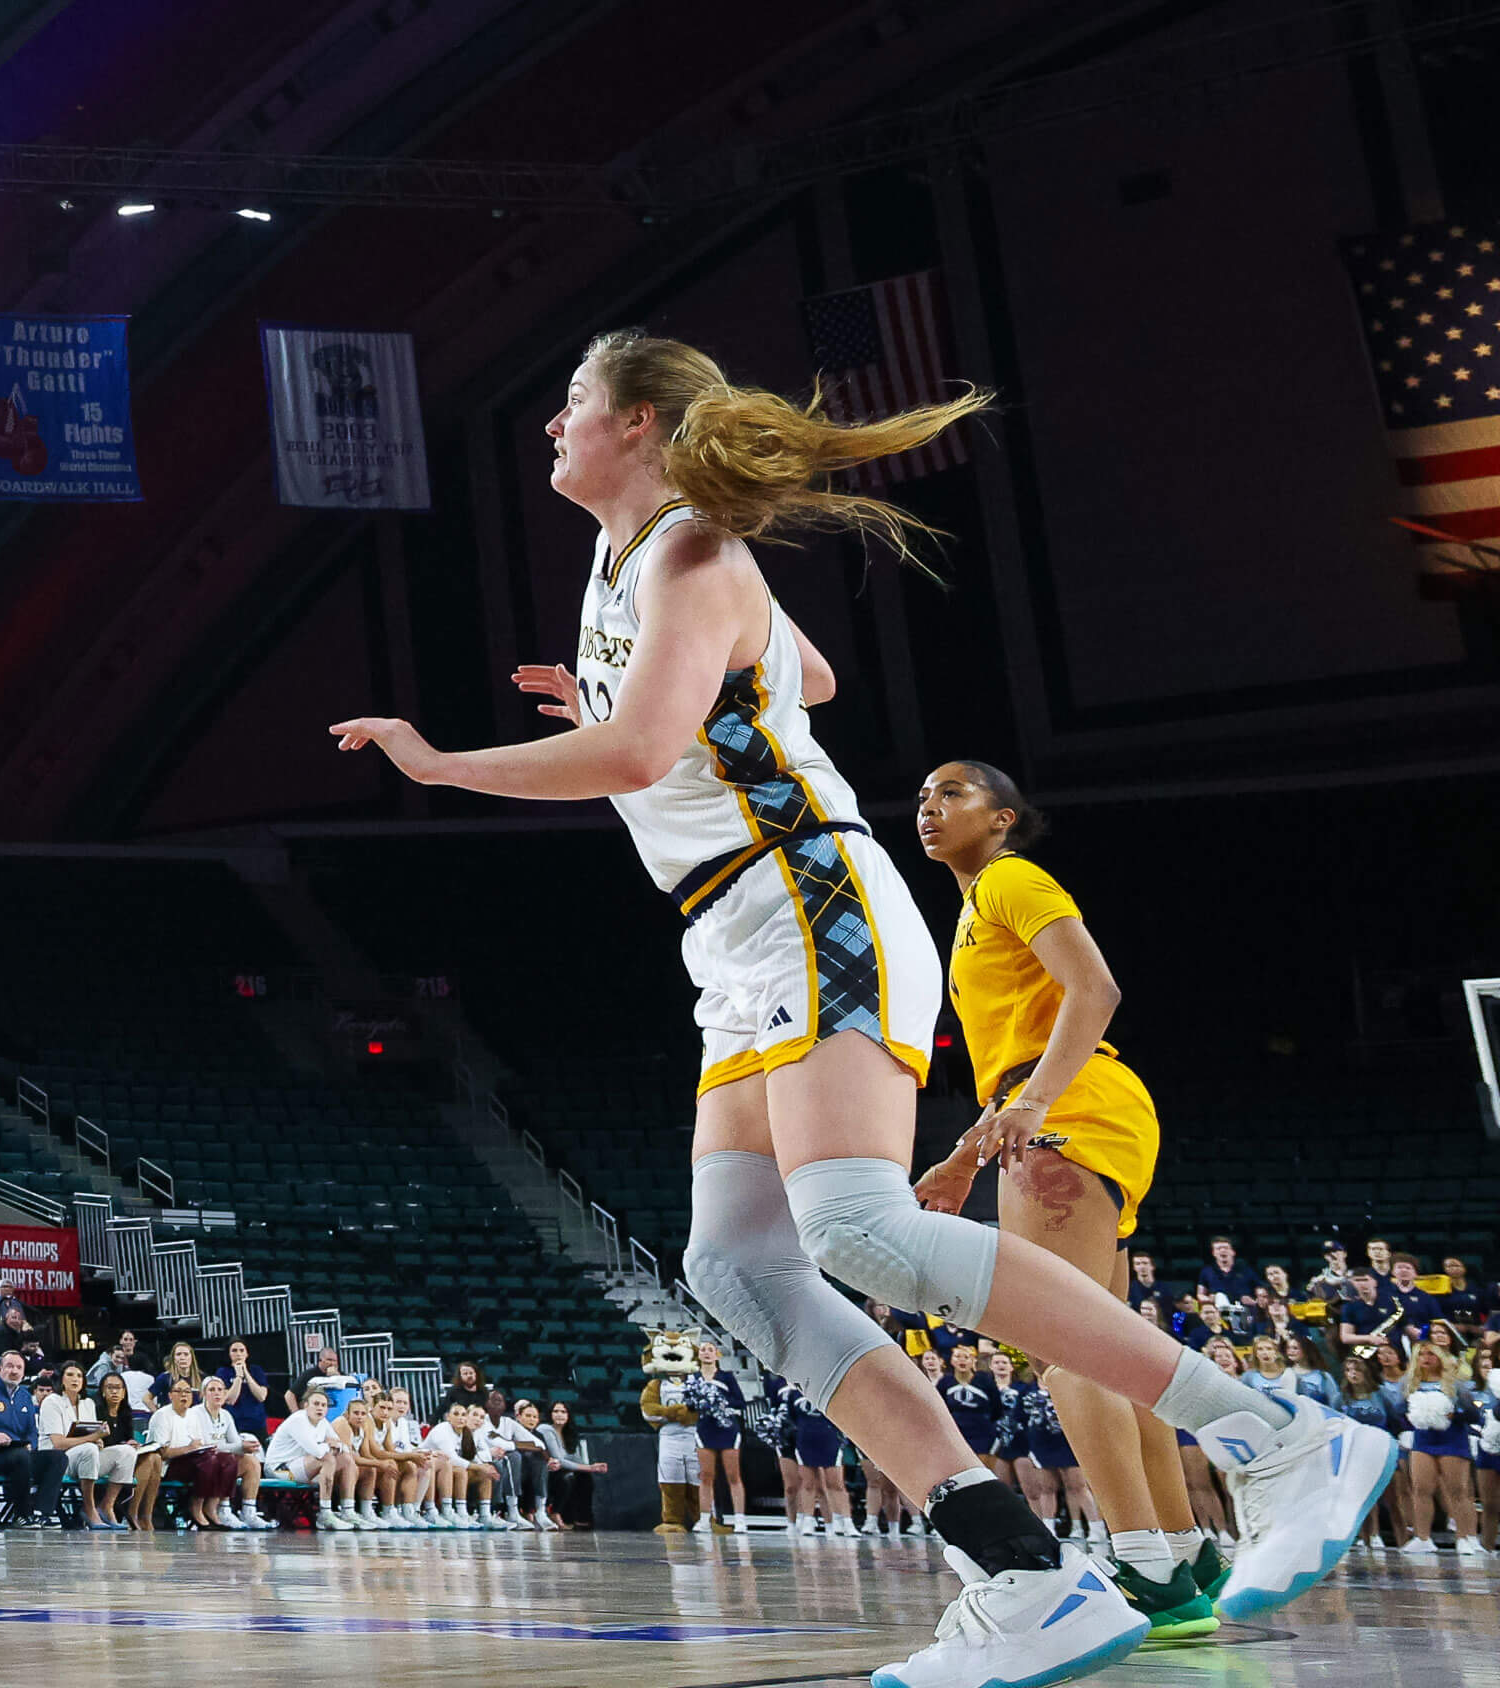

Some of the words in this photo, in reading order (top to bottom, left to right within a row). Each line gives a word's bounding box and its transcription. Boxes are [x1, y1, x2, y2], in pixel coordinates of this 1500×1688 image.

[12, 320, 90, 344] Arturo
[27, 370, 86, 393] Gatti
[80, 401, 103, 422] 15
[64, 423, 124, 445] Fights
[322, 422, 377, 440] 2003
[93, 481, 135, 495] HALL
